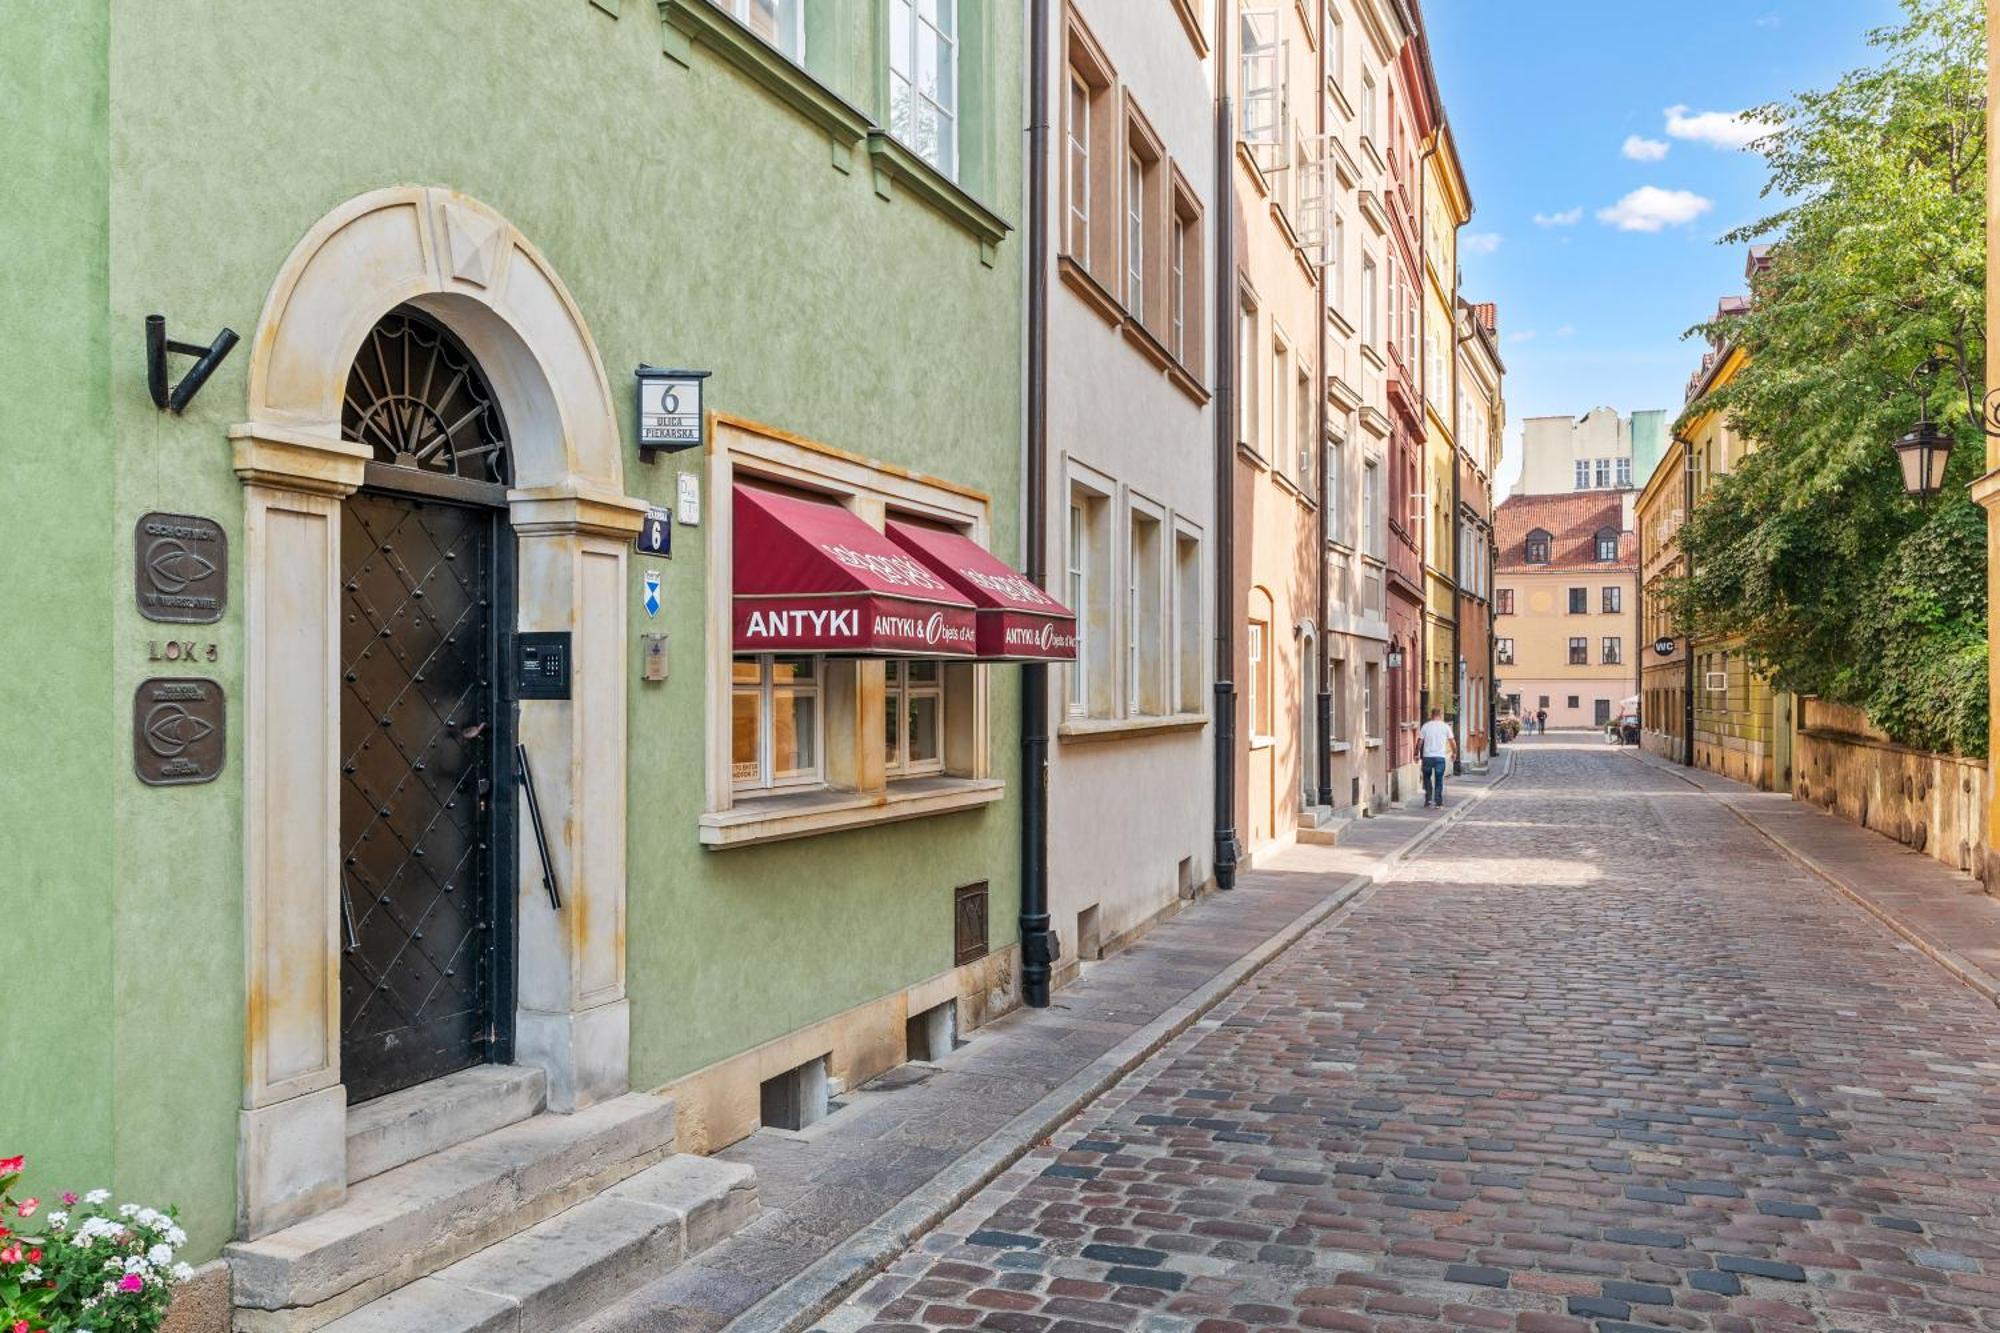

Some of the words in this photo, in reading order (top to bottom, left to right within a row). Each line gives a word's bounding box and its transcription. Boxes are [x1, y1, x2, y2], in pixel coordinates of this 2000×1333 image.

[661, 384, 680, 415] 6
[645, 428, 694, 438] PIEKARSKA
[656, 417, 683, 427] ULICA
[652, 521, 661, 550] 6
[746, 609, 859, 637] ANTYKI
[873, 615, 914, 637] ANTYKI
[916, 620, 925, 638] &
[1005, 627, 1034, 645] ANTYKI
[1656, 641, 1674, 651] WC
[148, 640, 199, 662] LOK
